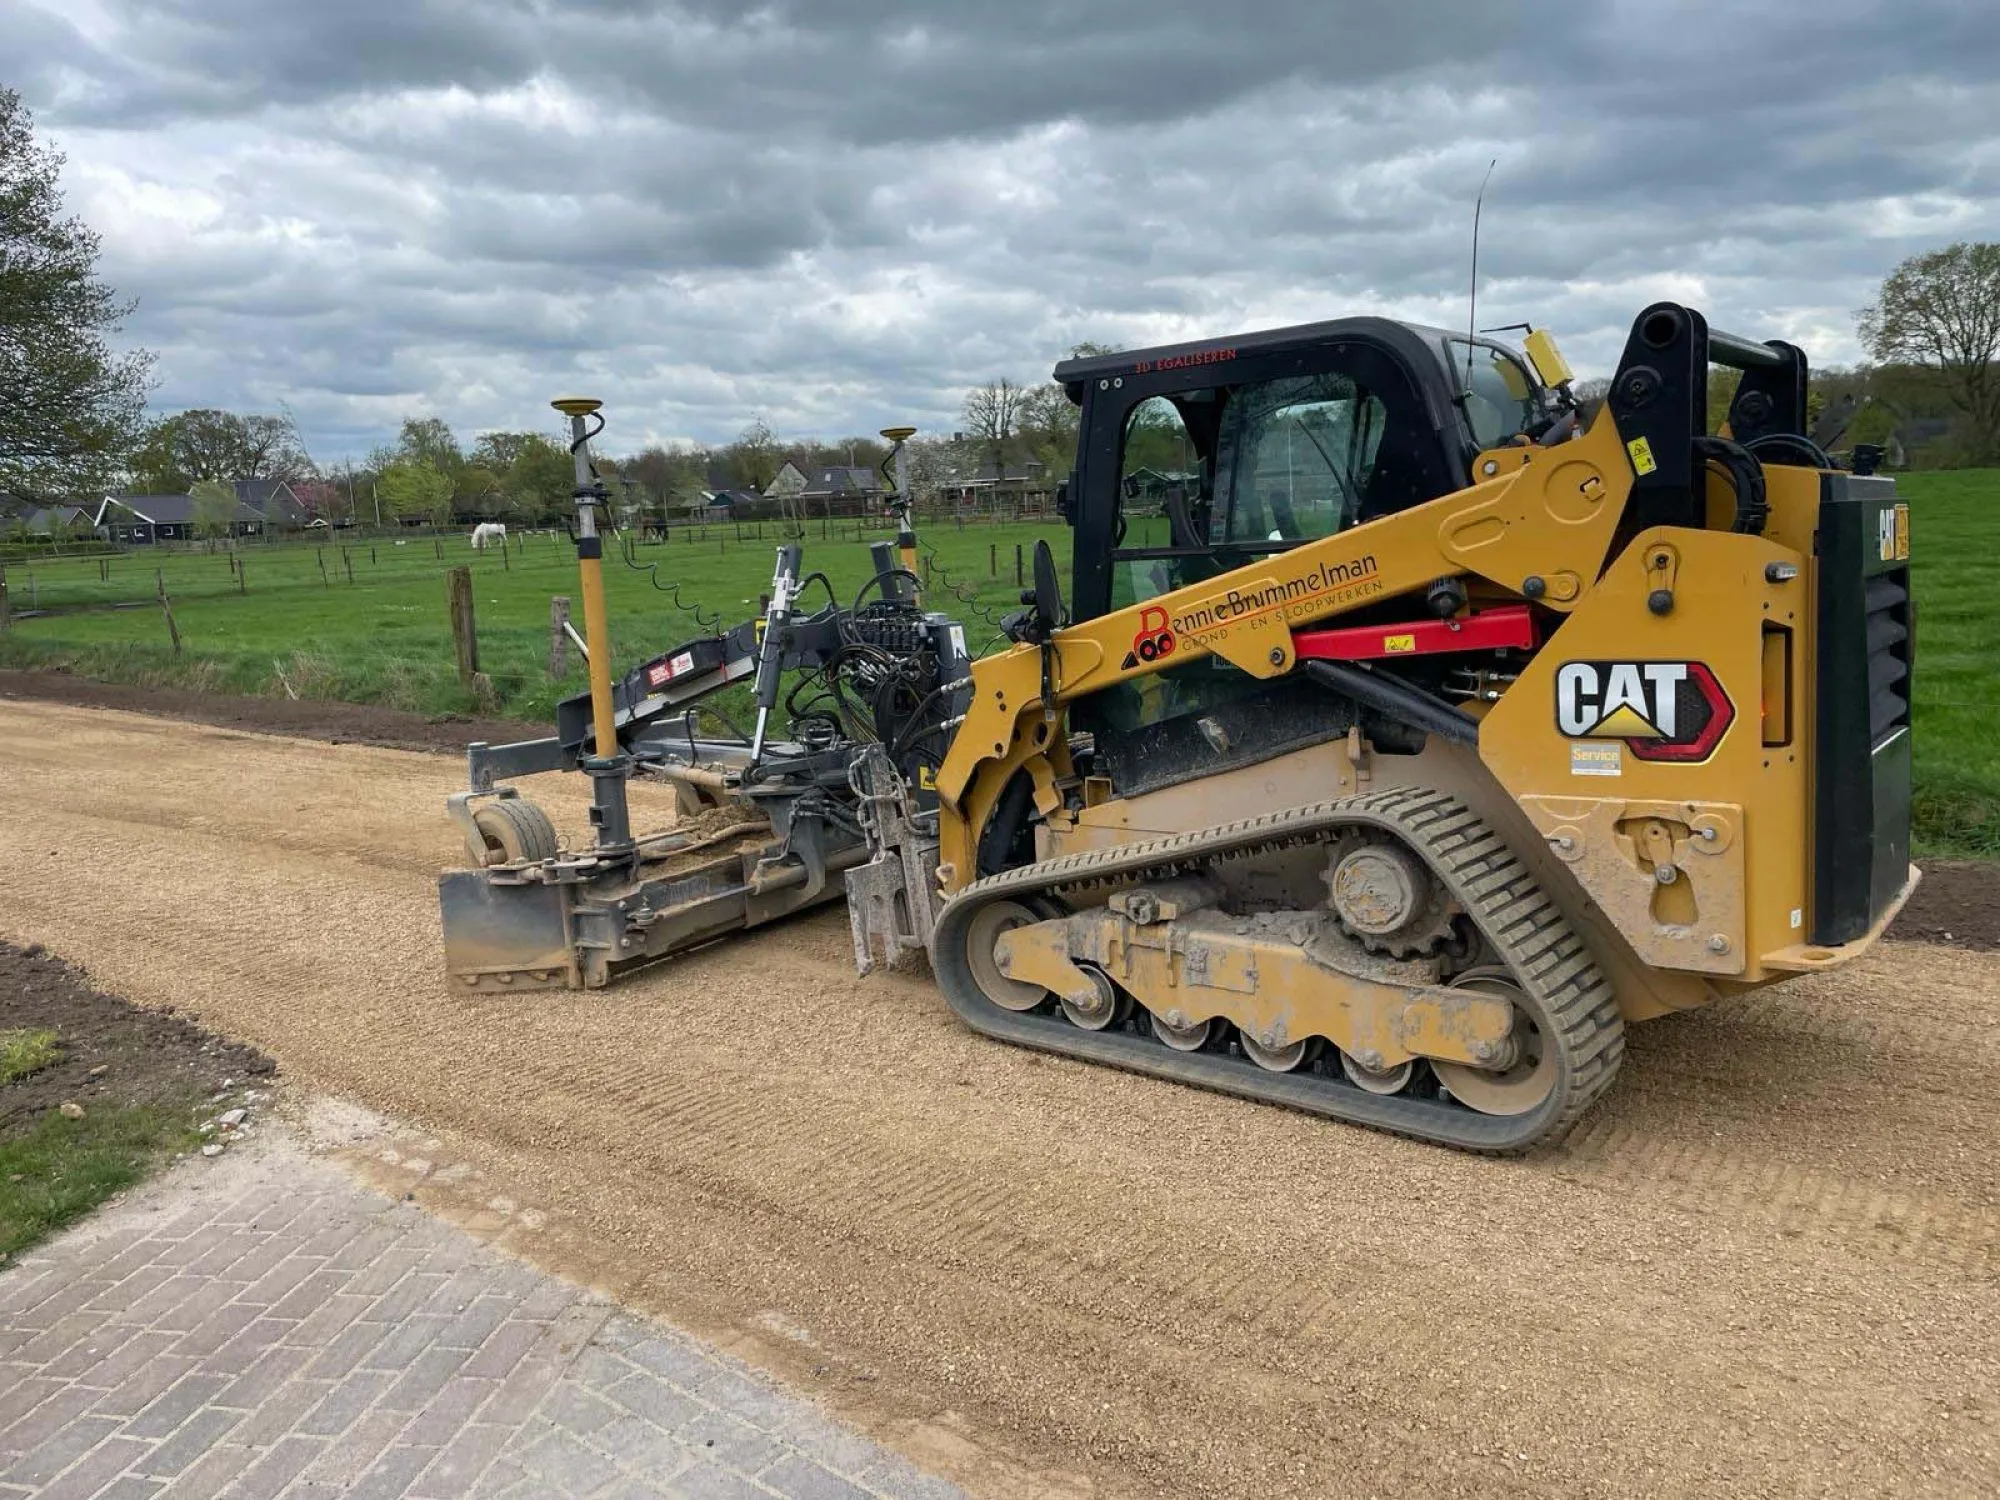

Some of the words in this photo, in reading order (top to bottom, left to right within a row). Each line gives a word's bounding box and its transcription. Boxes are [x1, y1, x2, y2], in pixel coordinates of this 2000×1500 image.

[1156, 348, 1236, 370] EGALISEREN
[1250, 616, 1268, 630] EN
[1558, 663, 1687, 738] CAT
[1572, 749, 1619, 761] Service
